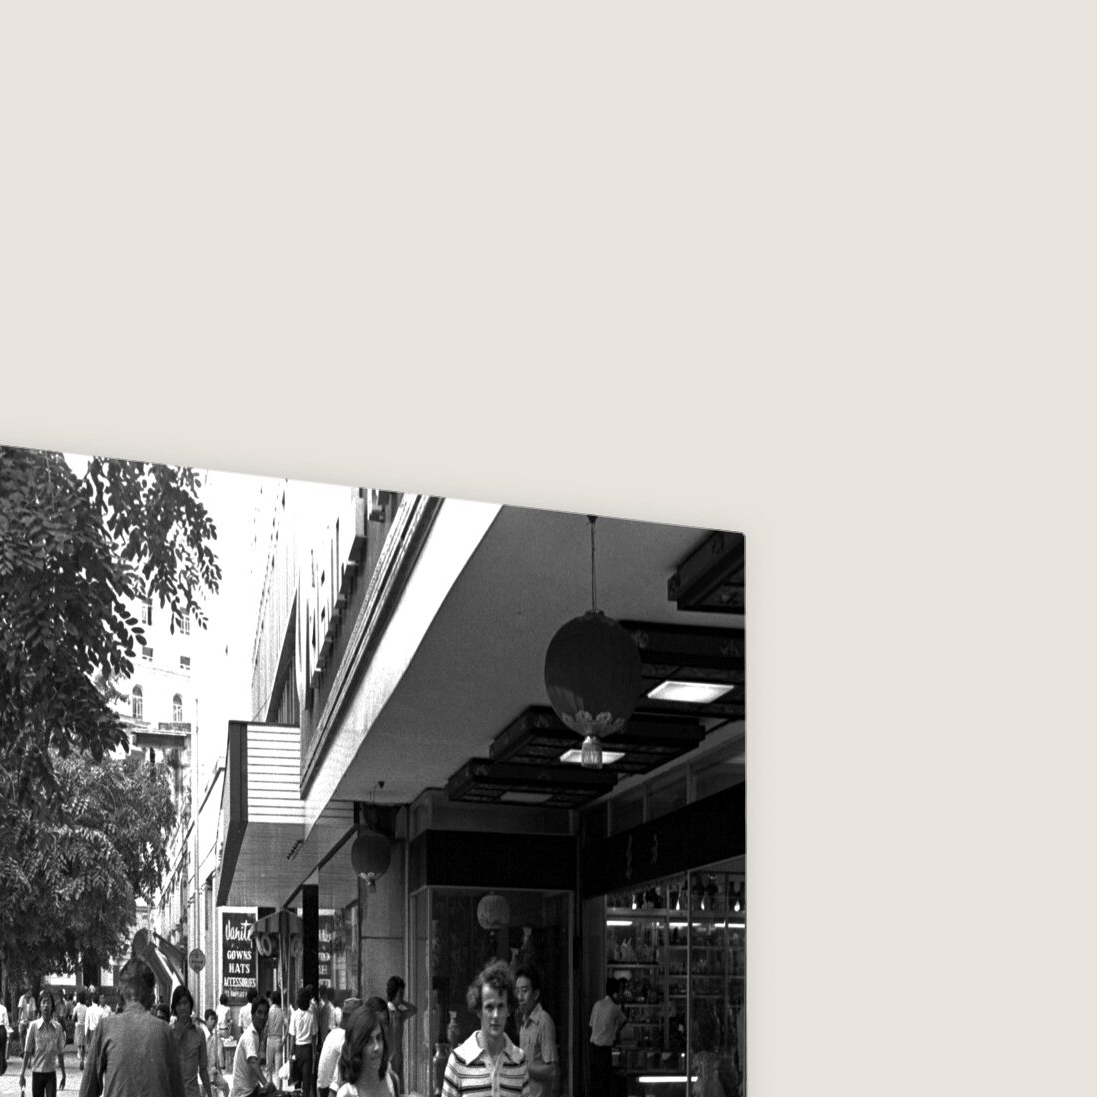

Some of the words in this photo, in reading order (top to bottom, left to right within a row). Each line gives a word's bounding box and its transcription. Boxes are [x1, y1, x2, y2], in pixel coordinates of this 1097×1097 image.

[226, 950, 252, 961] GOWNS
[228, 962, 251, 974] HATS
[223, 976, 256, 988] ACCESSORIES
